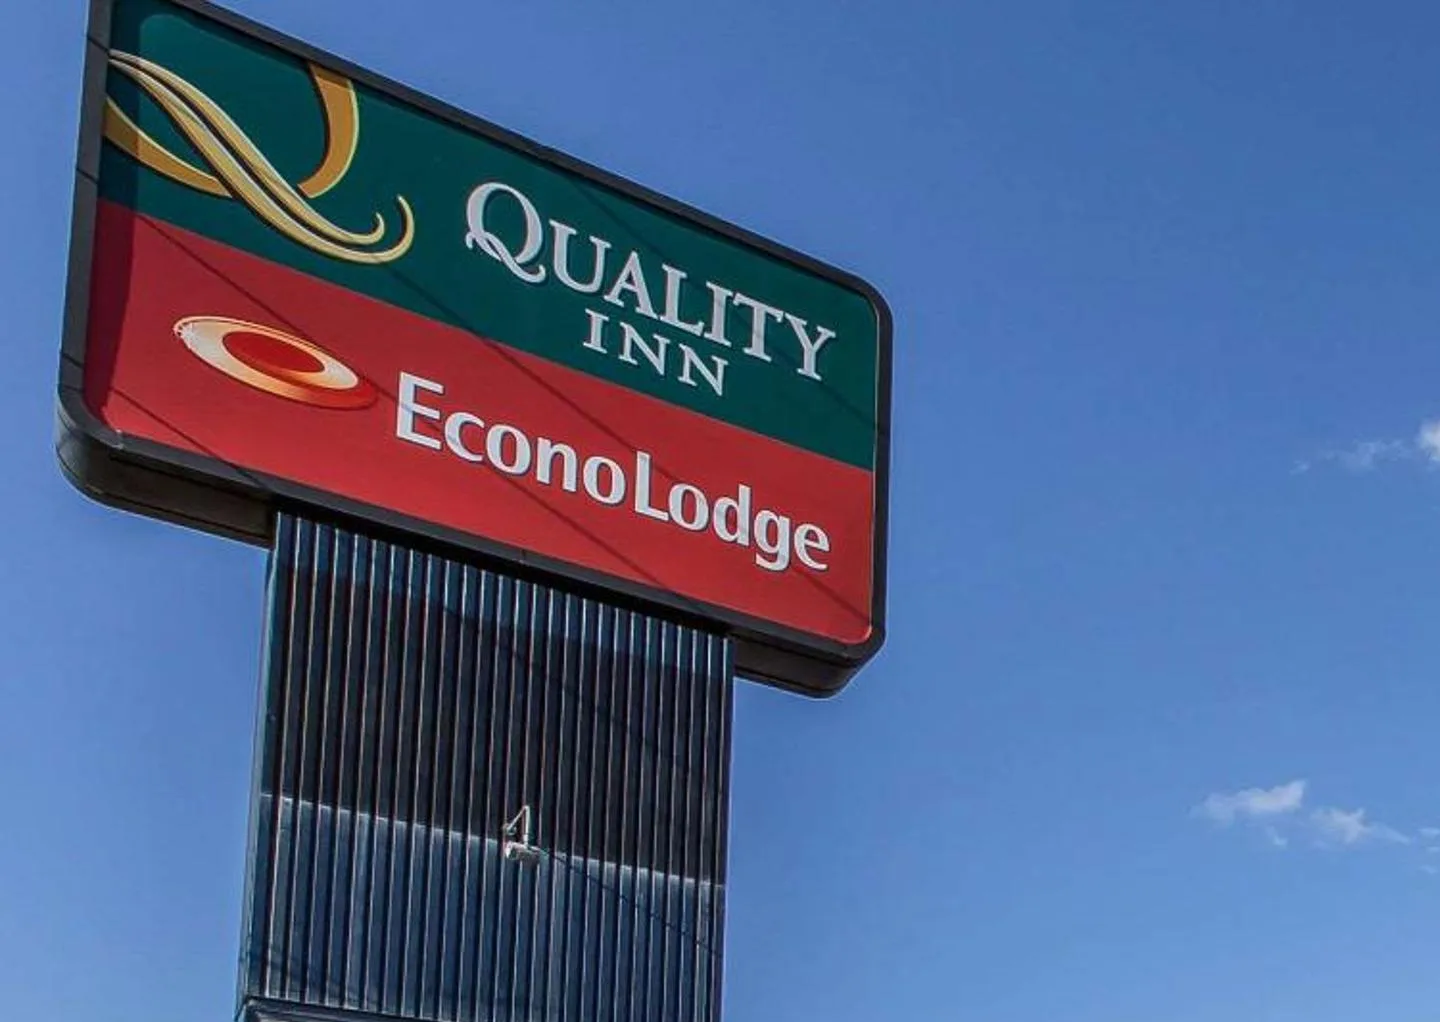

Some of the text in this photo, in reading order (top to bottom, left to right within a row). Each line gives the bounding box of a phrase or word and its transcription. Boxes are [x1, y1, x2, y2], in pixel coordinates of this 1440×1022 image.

[465, 181, 836, 382] QUALITY
[582, 307, 729, 397] INN
[394, 372, 831, 574] EconoLodge
